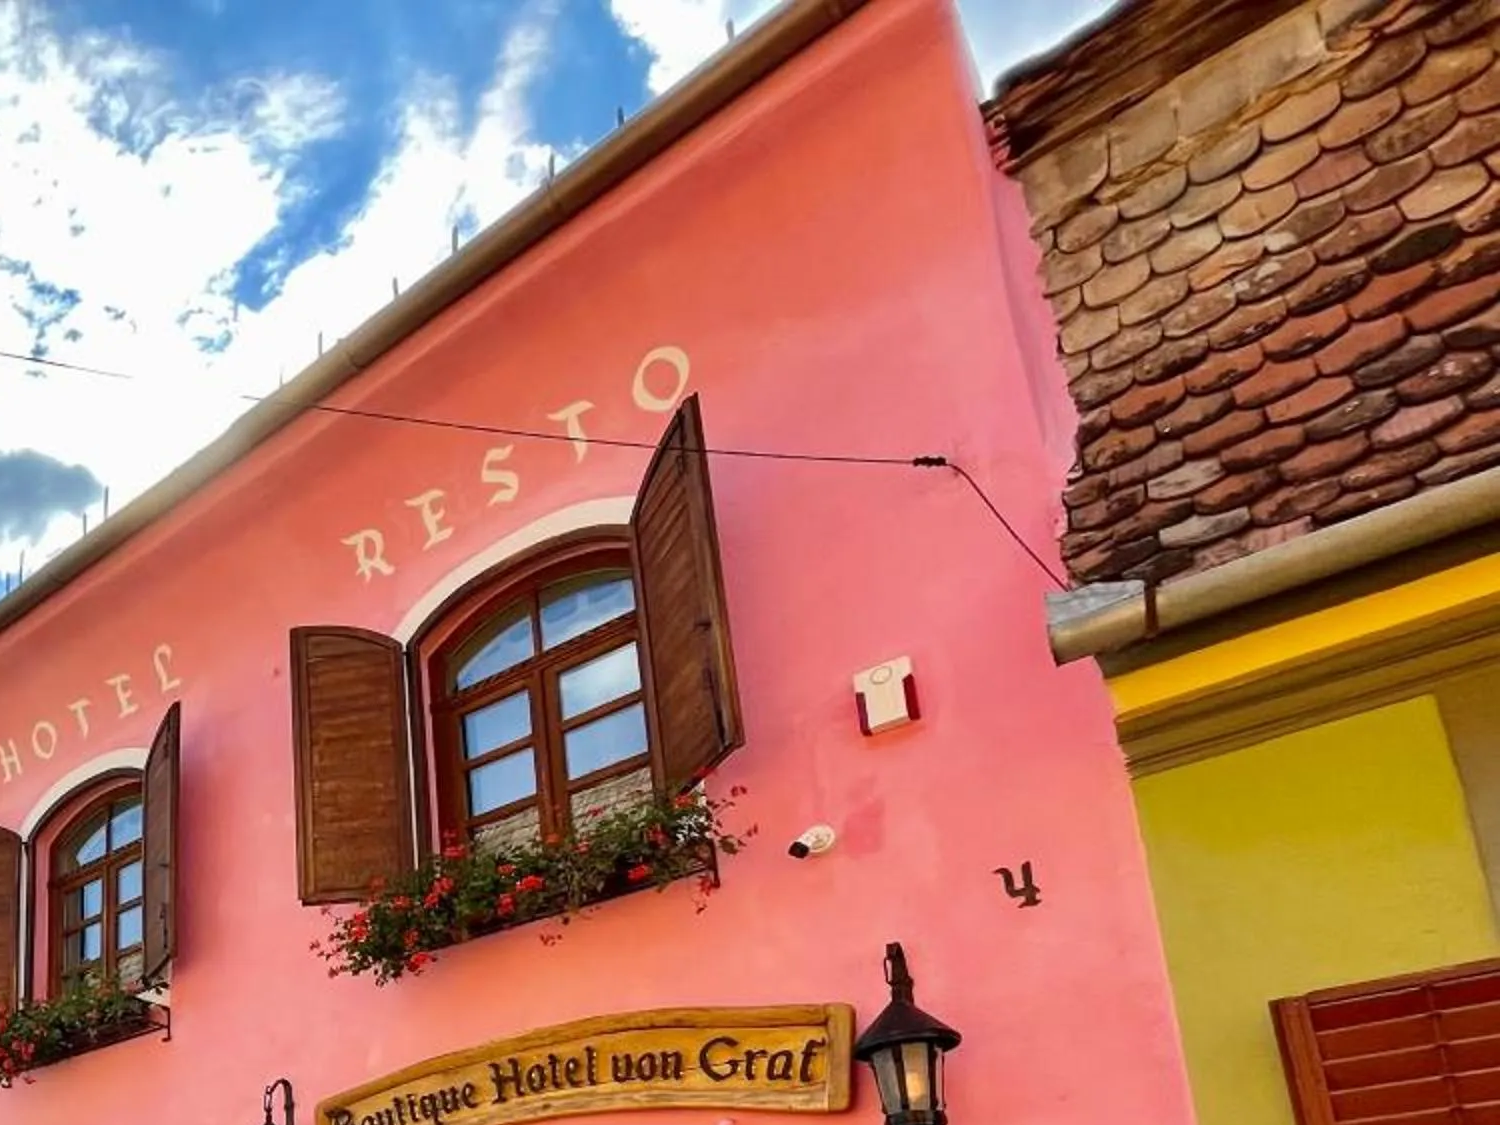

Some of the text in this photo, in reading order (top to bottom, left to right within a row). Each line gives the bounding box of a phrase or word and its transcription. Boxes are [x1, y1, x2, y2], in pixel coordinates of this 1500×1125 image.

[340, 345, 690, 584] RESTO
[488, 1045, 597, 1104] Hotel
[699, 1036, 826, 1083] Graf
